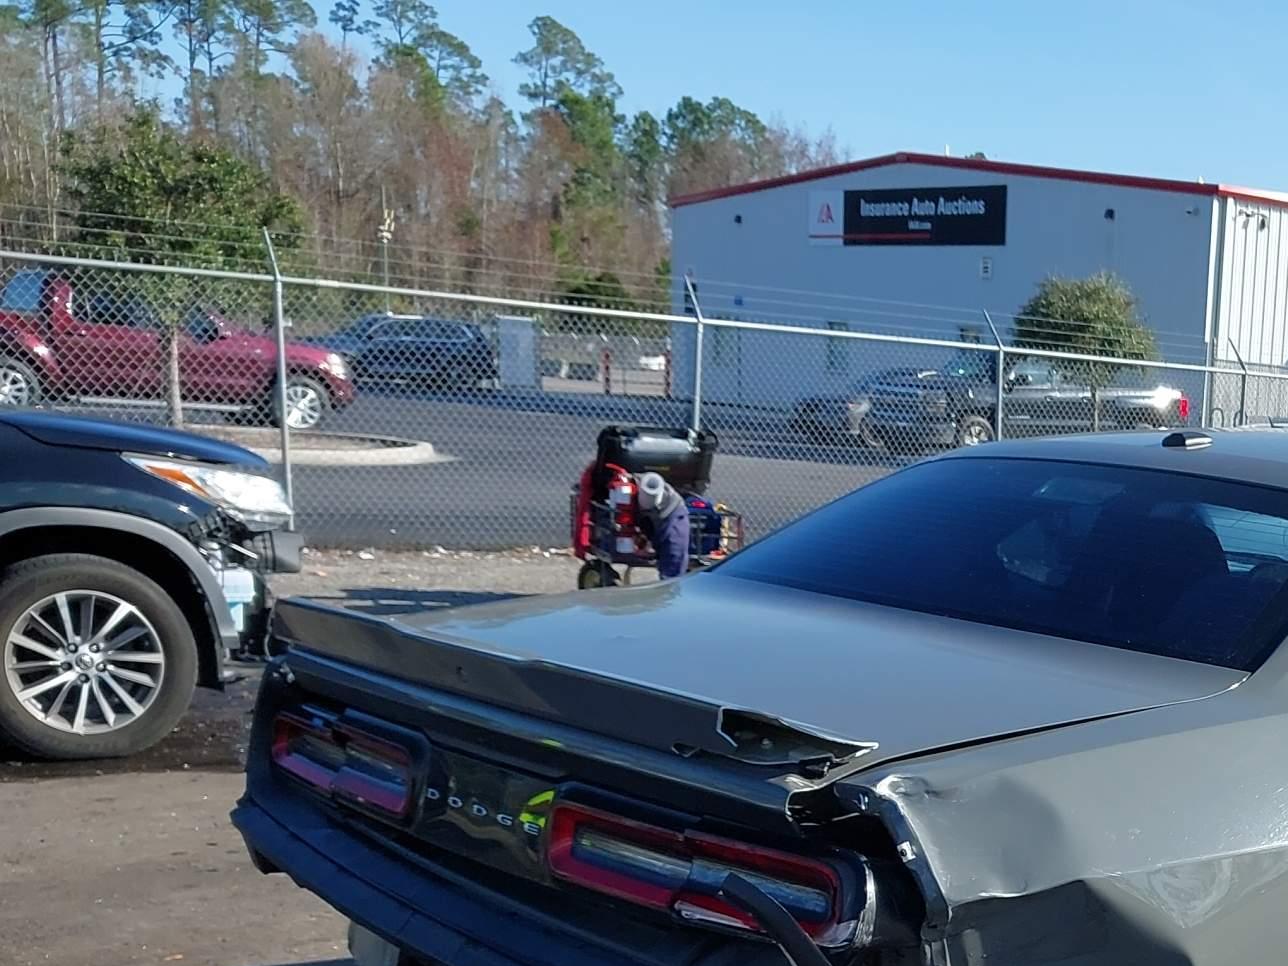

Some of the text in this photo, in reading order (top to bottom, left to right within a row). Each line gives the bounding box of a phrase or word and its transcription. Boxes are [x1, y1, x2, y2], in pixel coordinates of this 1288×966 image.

[860, 195, 985, 216] Insurance Auto Auctions
[426, 787, 540, 836] DODGE
